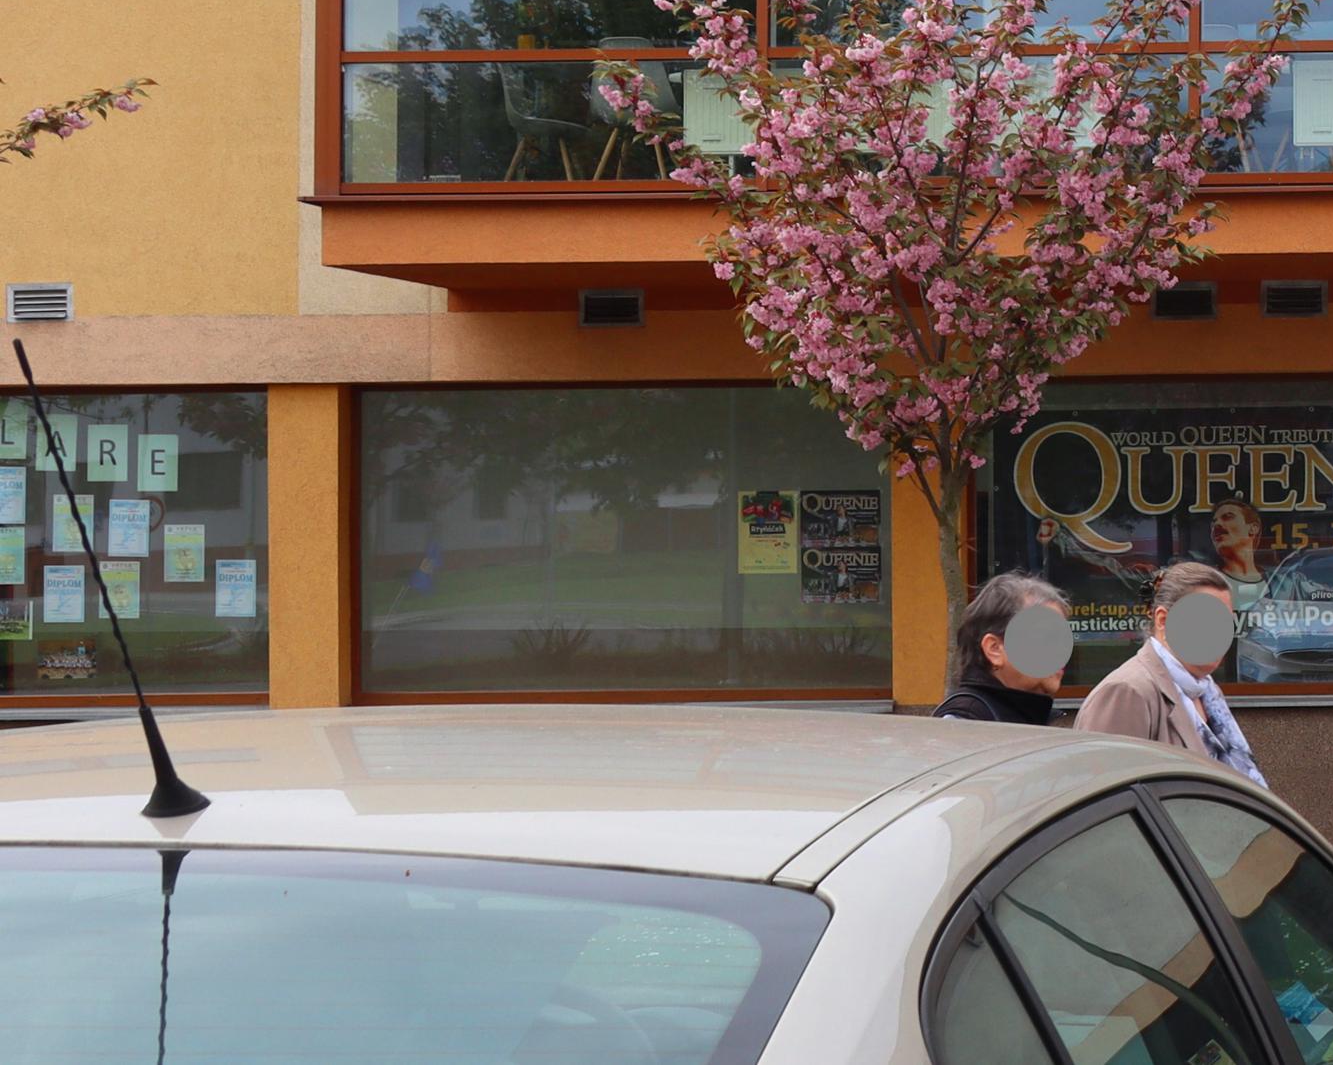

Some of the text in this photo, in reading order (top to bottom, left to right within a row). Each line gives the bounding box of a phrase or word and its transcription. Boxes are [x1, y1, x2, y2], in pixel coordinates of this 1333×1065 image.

[1111, 430, 1176, 447] WORLD
[1179, 425, 1268, 447] QUEEN
[111, 513, 147, 523] DIPLOM
[1270, 522, 1318, 551] 15.
[47, 579, 82, 588] DIPLOM
[218, 573, 254, 583] DIPLOM
[1068, 617, 1149, 631] msticket.c
[1232, 605, 1277, 634] yně
[1284, 610, 1298, 626] v
